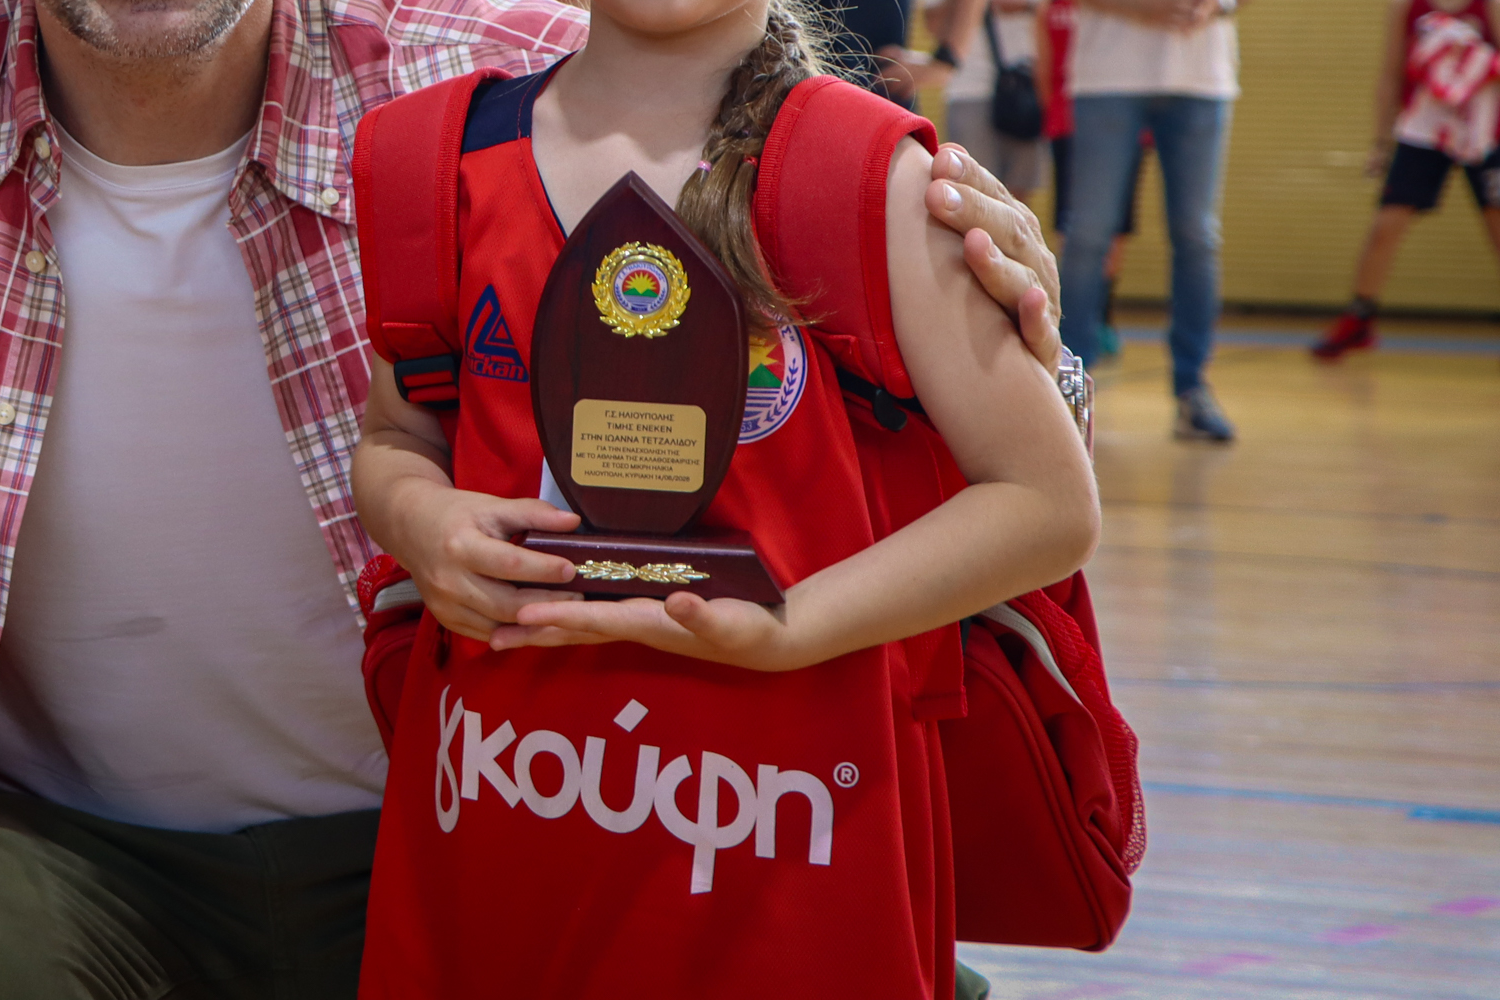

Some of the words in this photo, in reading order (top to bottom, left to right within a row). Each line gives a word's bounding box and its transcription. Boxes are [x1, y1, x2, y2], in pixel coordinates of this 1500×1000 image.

[618, 411, 675, 422] ΗΛΙΟΥΠΟΛΗΣ
[606, 422, 634, 431] ΤΙΜΗΣ
[636, 424, 673, 433] ΕΝΕΚΕΝ
[580, 433, 603, 441] ΣΤΗΝ
[605, 434, 640, 443] ΙΩΑΝΝΑ
[641, 436, 697, 447] ΤΕΤΖΑΛΙΔΟΥ
[597, 453, 624, 461] ΑΘΛΗΜΑ
